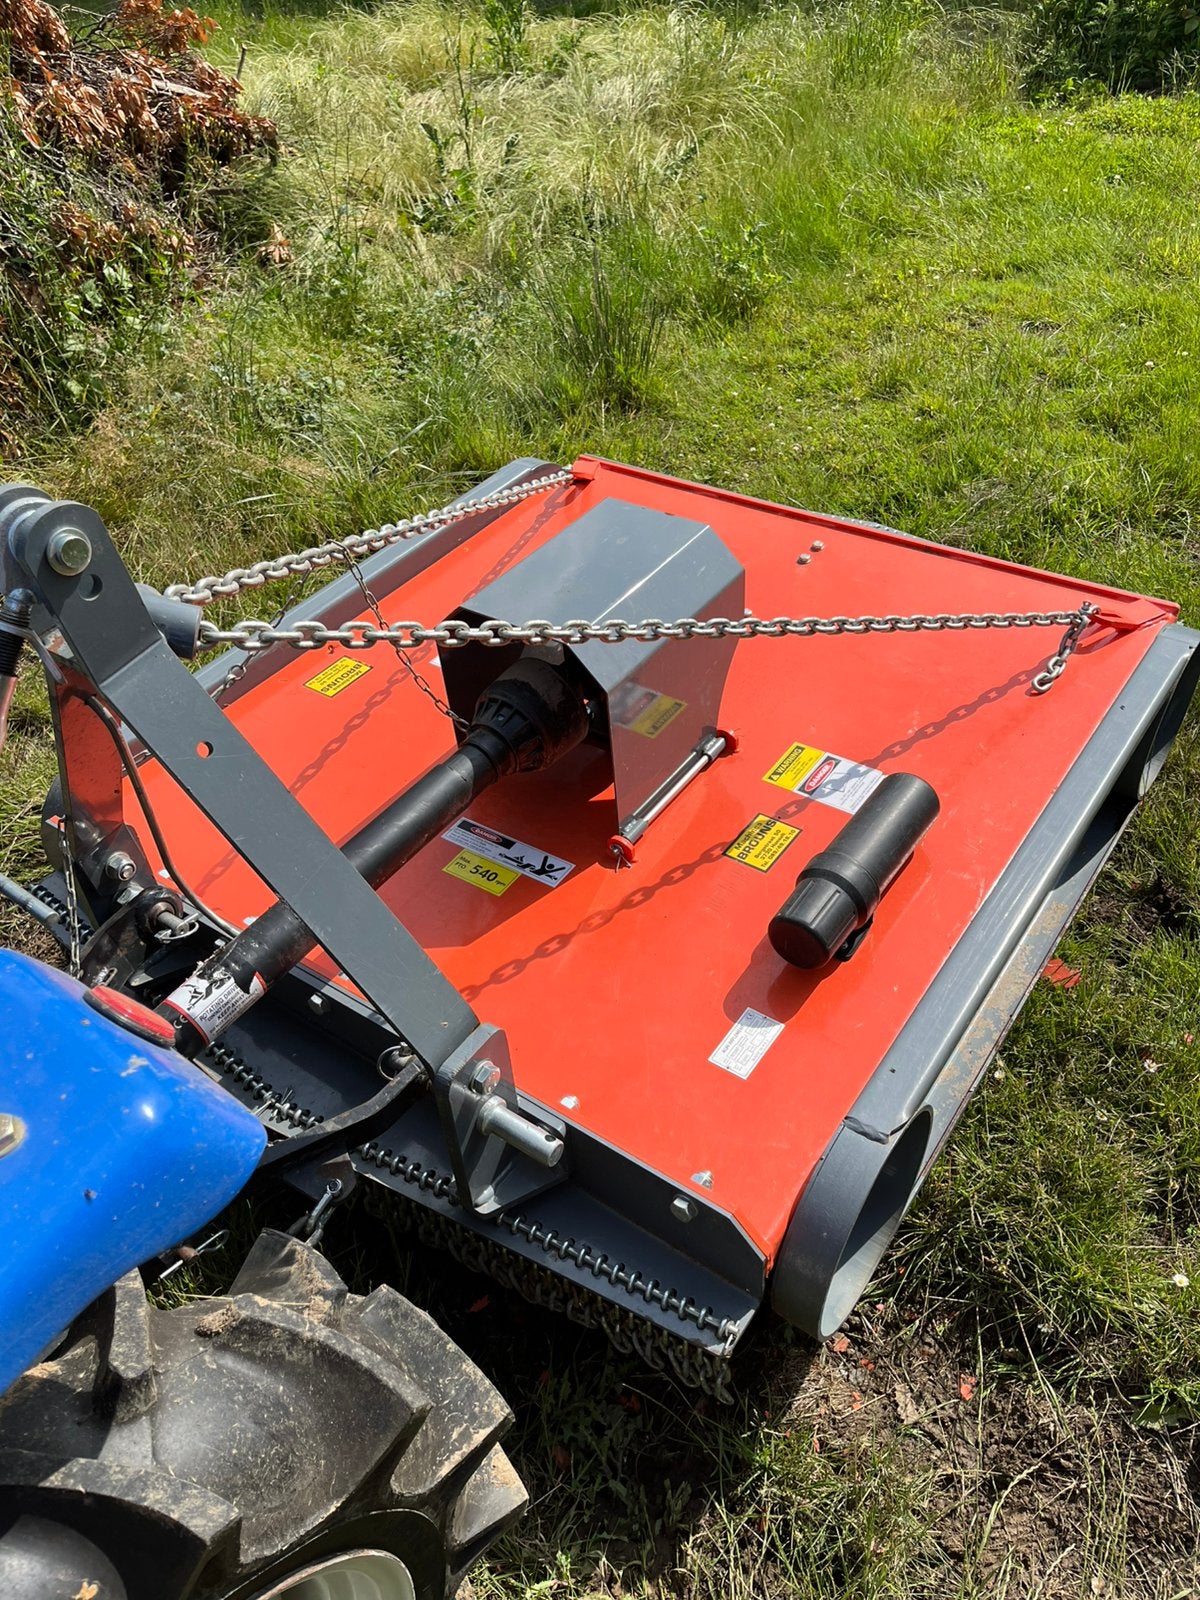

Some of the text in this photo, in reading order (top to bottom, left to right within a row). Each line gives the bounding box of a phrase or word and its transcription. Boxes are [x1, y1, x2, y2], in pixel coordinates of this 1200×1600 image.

[777, 748, 802, 773] WARNING
[808, 764, 831, 787] DANGER
[475, 828, 499, 842] DANGER
[737, 819, 777, 860] BROUNS
[455, 861, 467, 869] PTO
[469, 864, 499, 882] 540
[199, 998, 224, 1022] ROTATING
[217, 1006, 231, 1019] KEEP
